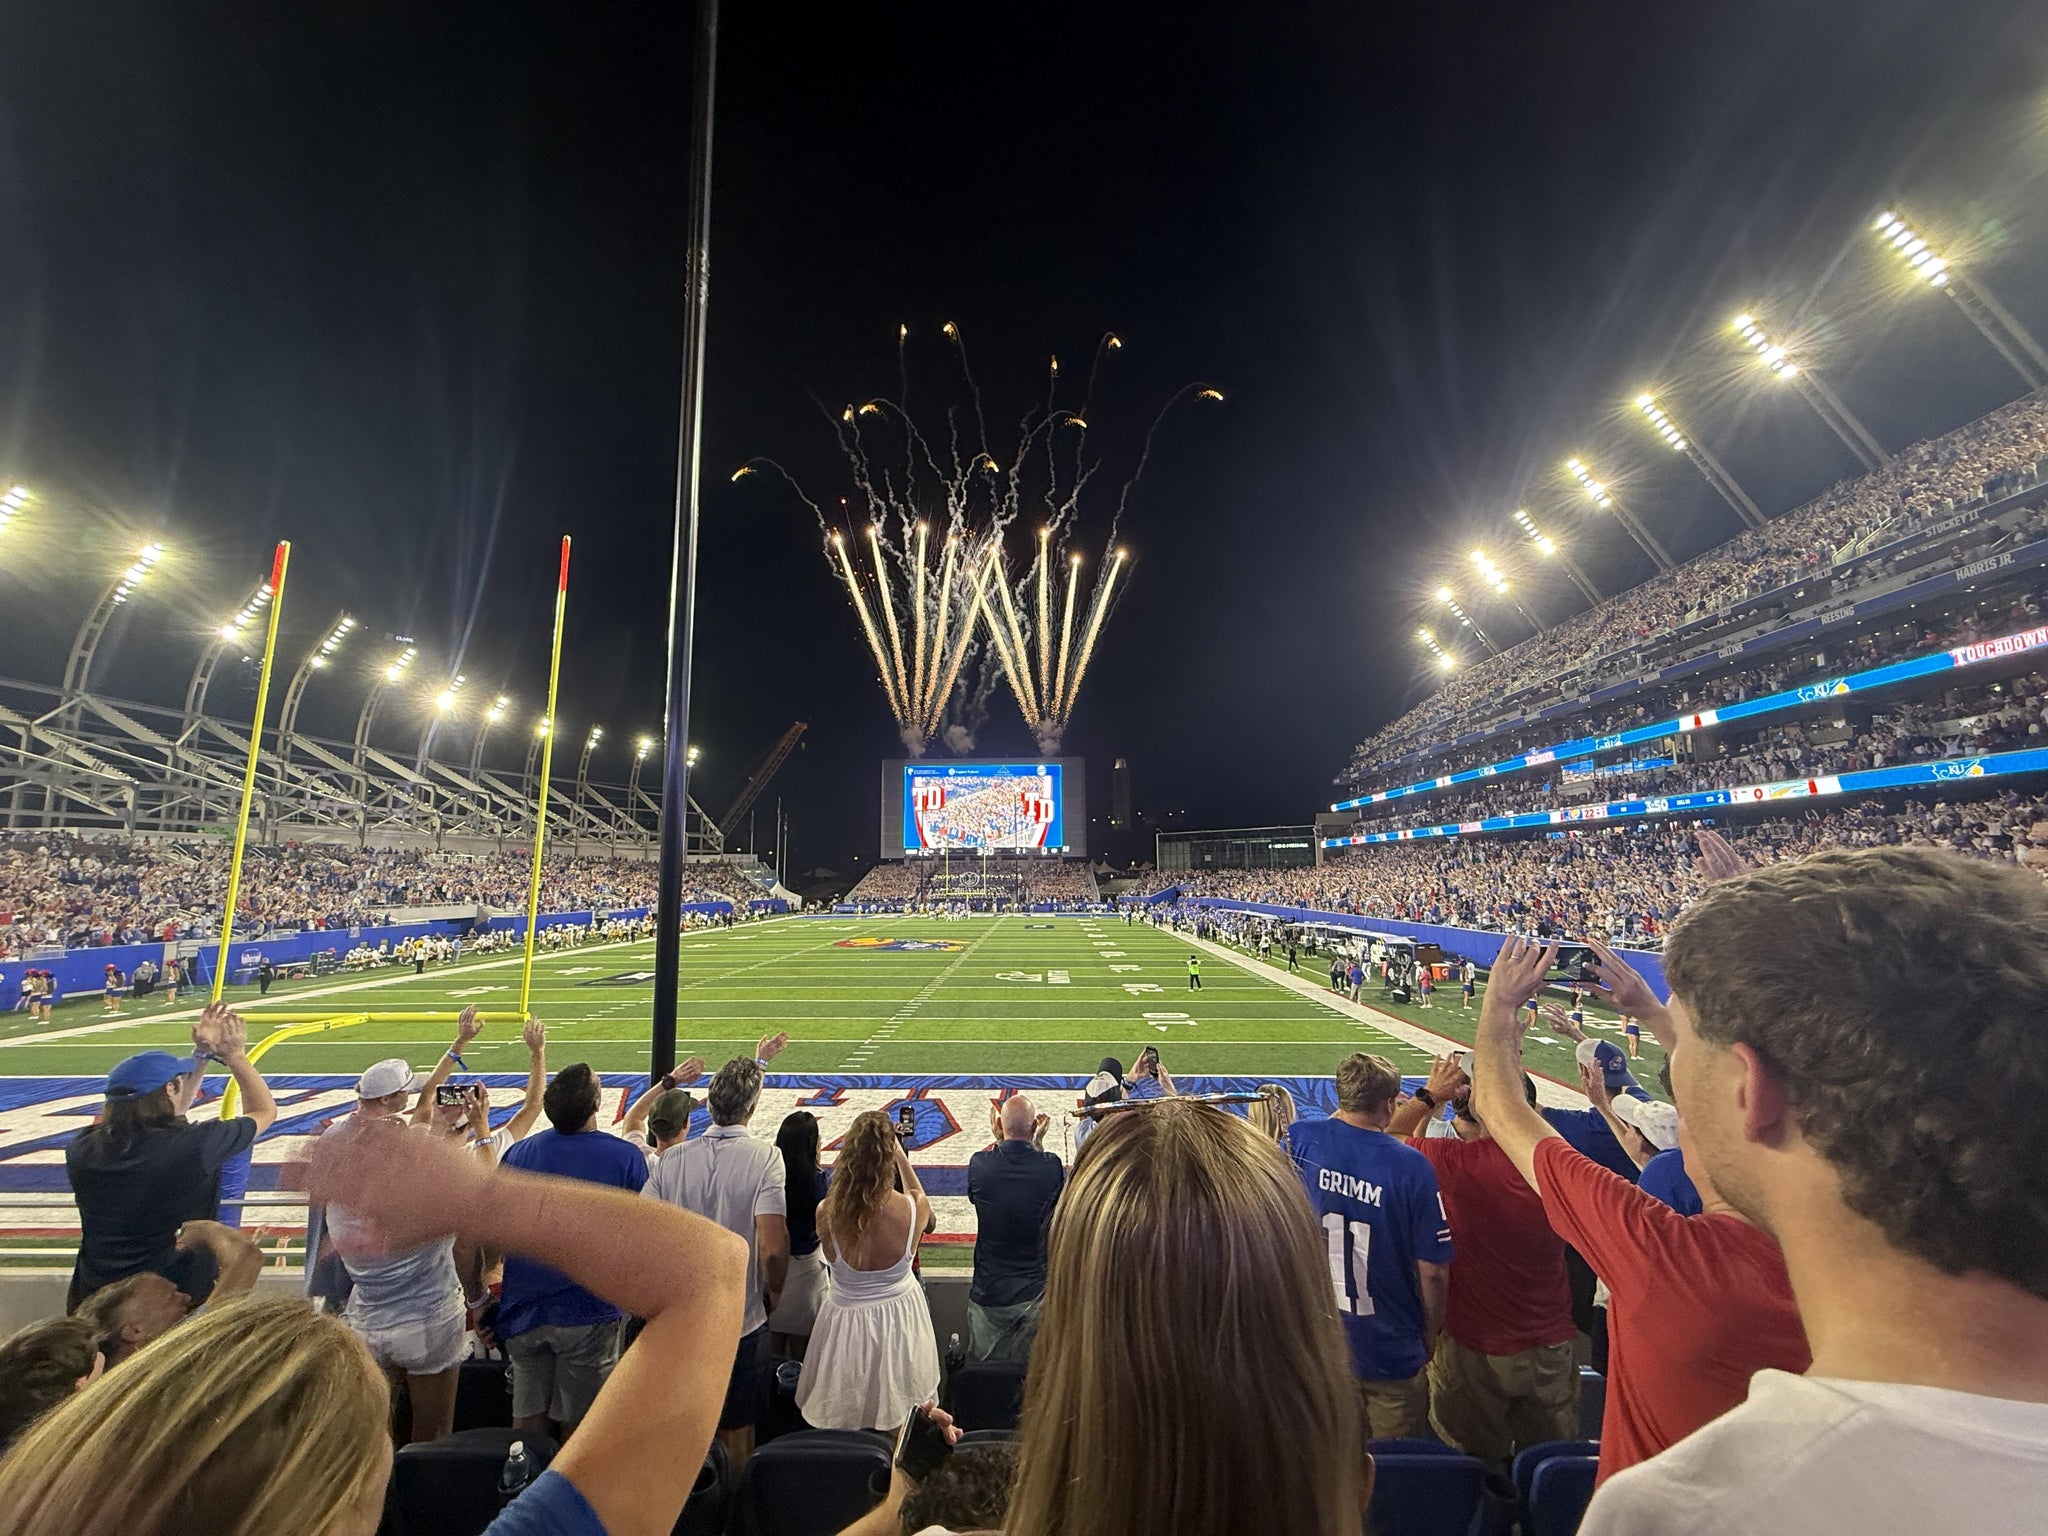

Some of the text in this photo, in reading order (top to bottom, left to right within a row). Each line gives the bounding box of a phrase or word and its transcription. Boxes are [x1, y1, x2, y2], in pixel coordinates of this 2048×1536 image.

[1955, 557, 1997, 581] HARRIS
[1821, 606, 1855, 625] REESING
[1952, 628, 2048, 666] TOUCHDOWN
[1814, 683, 1830, 697] KU
[1948, 763, 1965, 776] KU
[912, 787, 941, 810] TD
[1025, 792, 1054, 823] TD
[1645, 799, 1668, 813] 3:50
[1585, 809, 1595, 818] 22
[1319, 1168, 1382, 1208] GRIMM
[1322, 1212, 1376, 1317] 11
